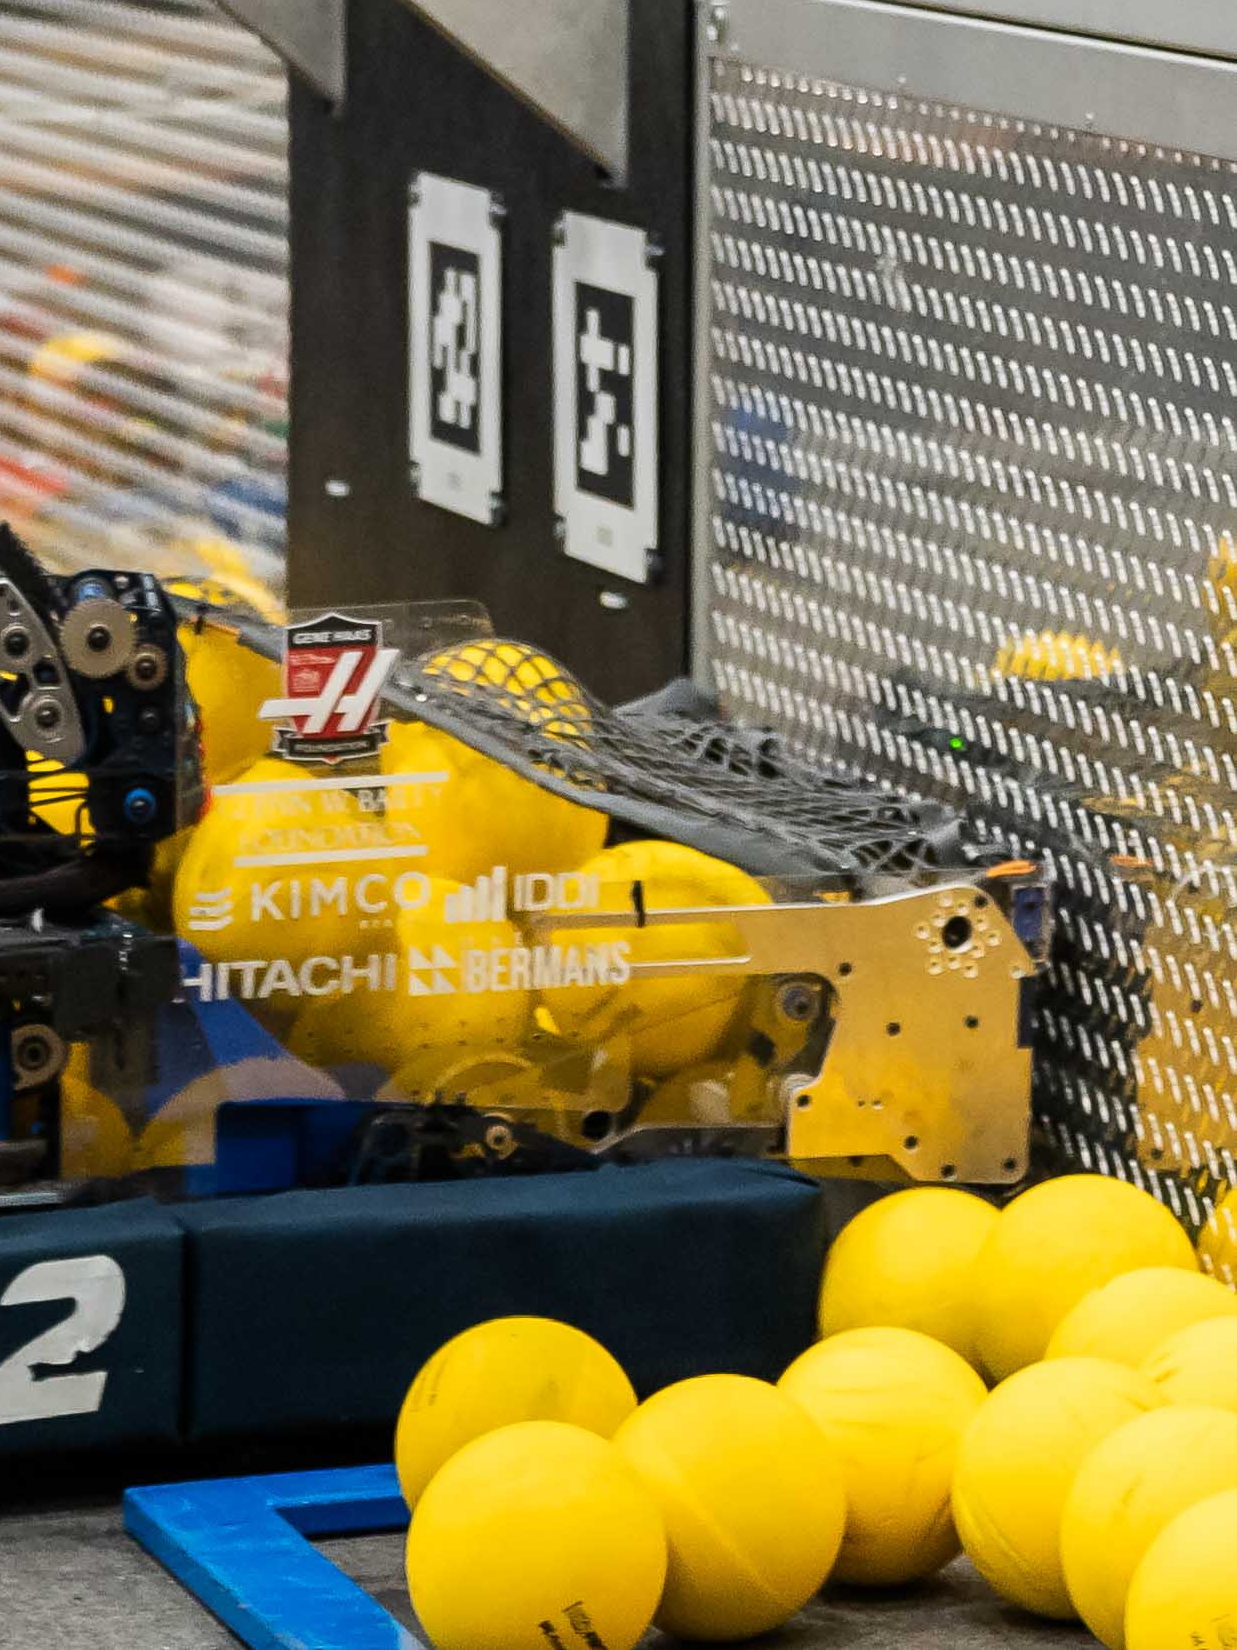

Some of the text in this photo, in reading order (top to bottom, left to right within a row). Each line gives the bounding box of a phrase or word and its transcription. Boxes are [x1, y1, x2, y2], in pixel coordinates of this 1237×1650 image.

[251, 871, 431, 922] KIMCO
[182, 952, 397, 1002] HITACHI
[466, 942, 631, 994] BERMANS
